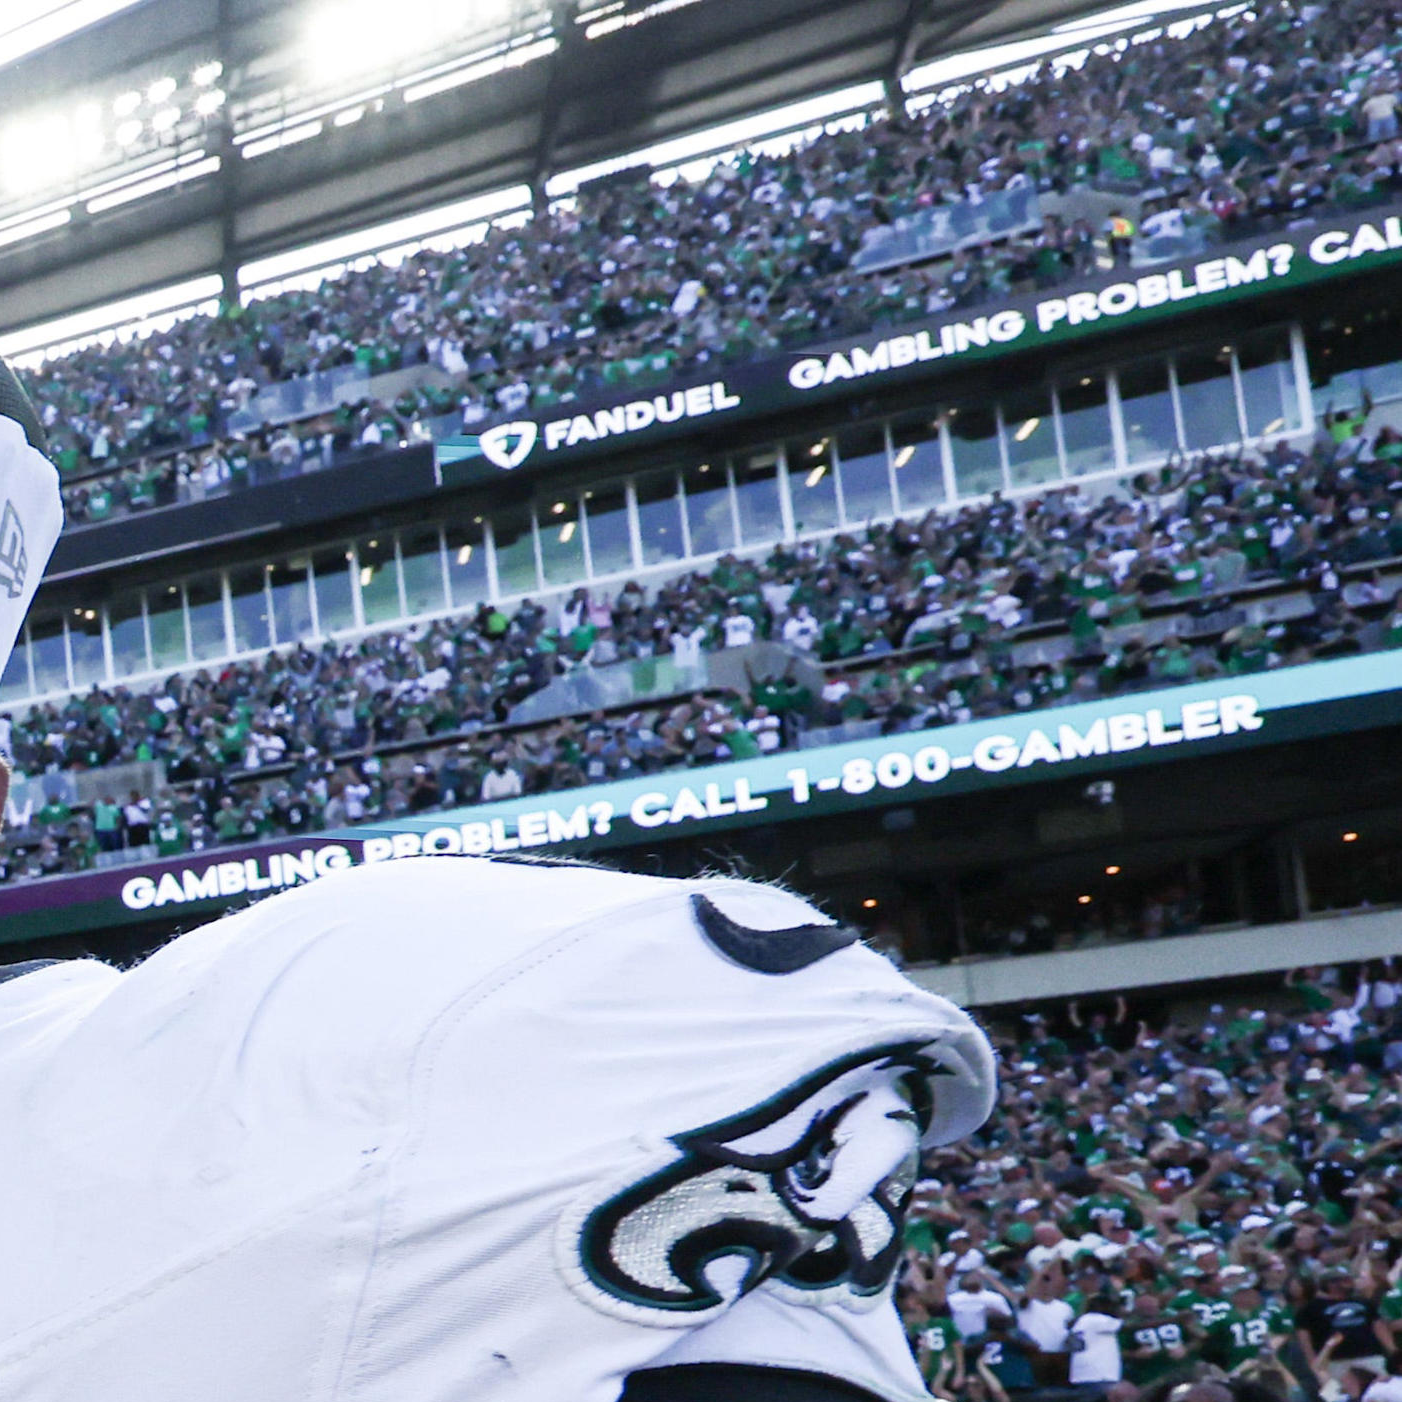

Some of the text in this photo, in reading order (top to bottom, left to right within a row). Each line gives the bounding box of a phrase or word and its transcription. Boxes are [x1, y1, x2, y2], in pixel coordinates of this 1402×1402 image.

[788, 310, 1026, 390] GAMBLING
[1036, 243, 1294, 332] PROBLEM?
[545, 381, 741, 450] FANDUEL
[120, 695, 1264, 910] GAMBLING PROBLEM? CALL 1-800-GAMBLER
